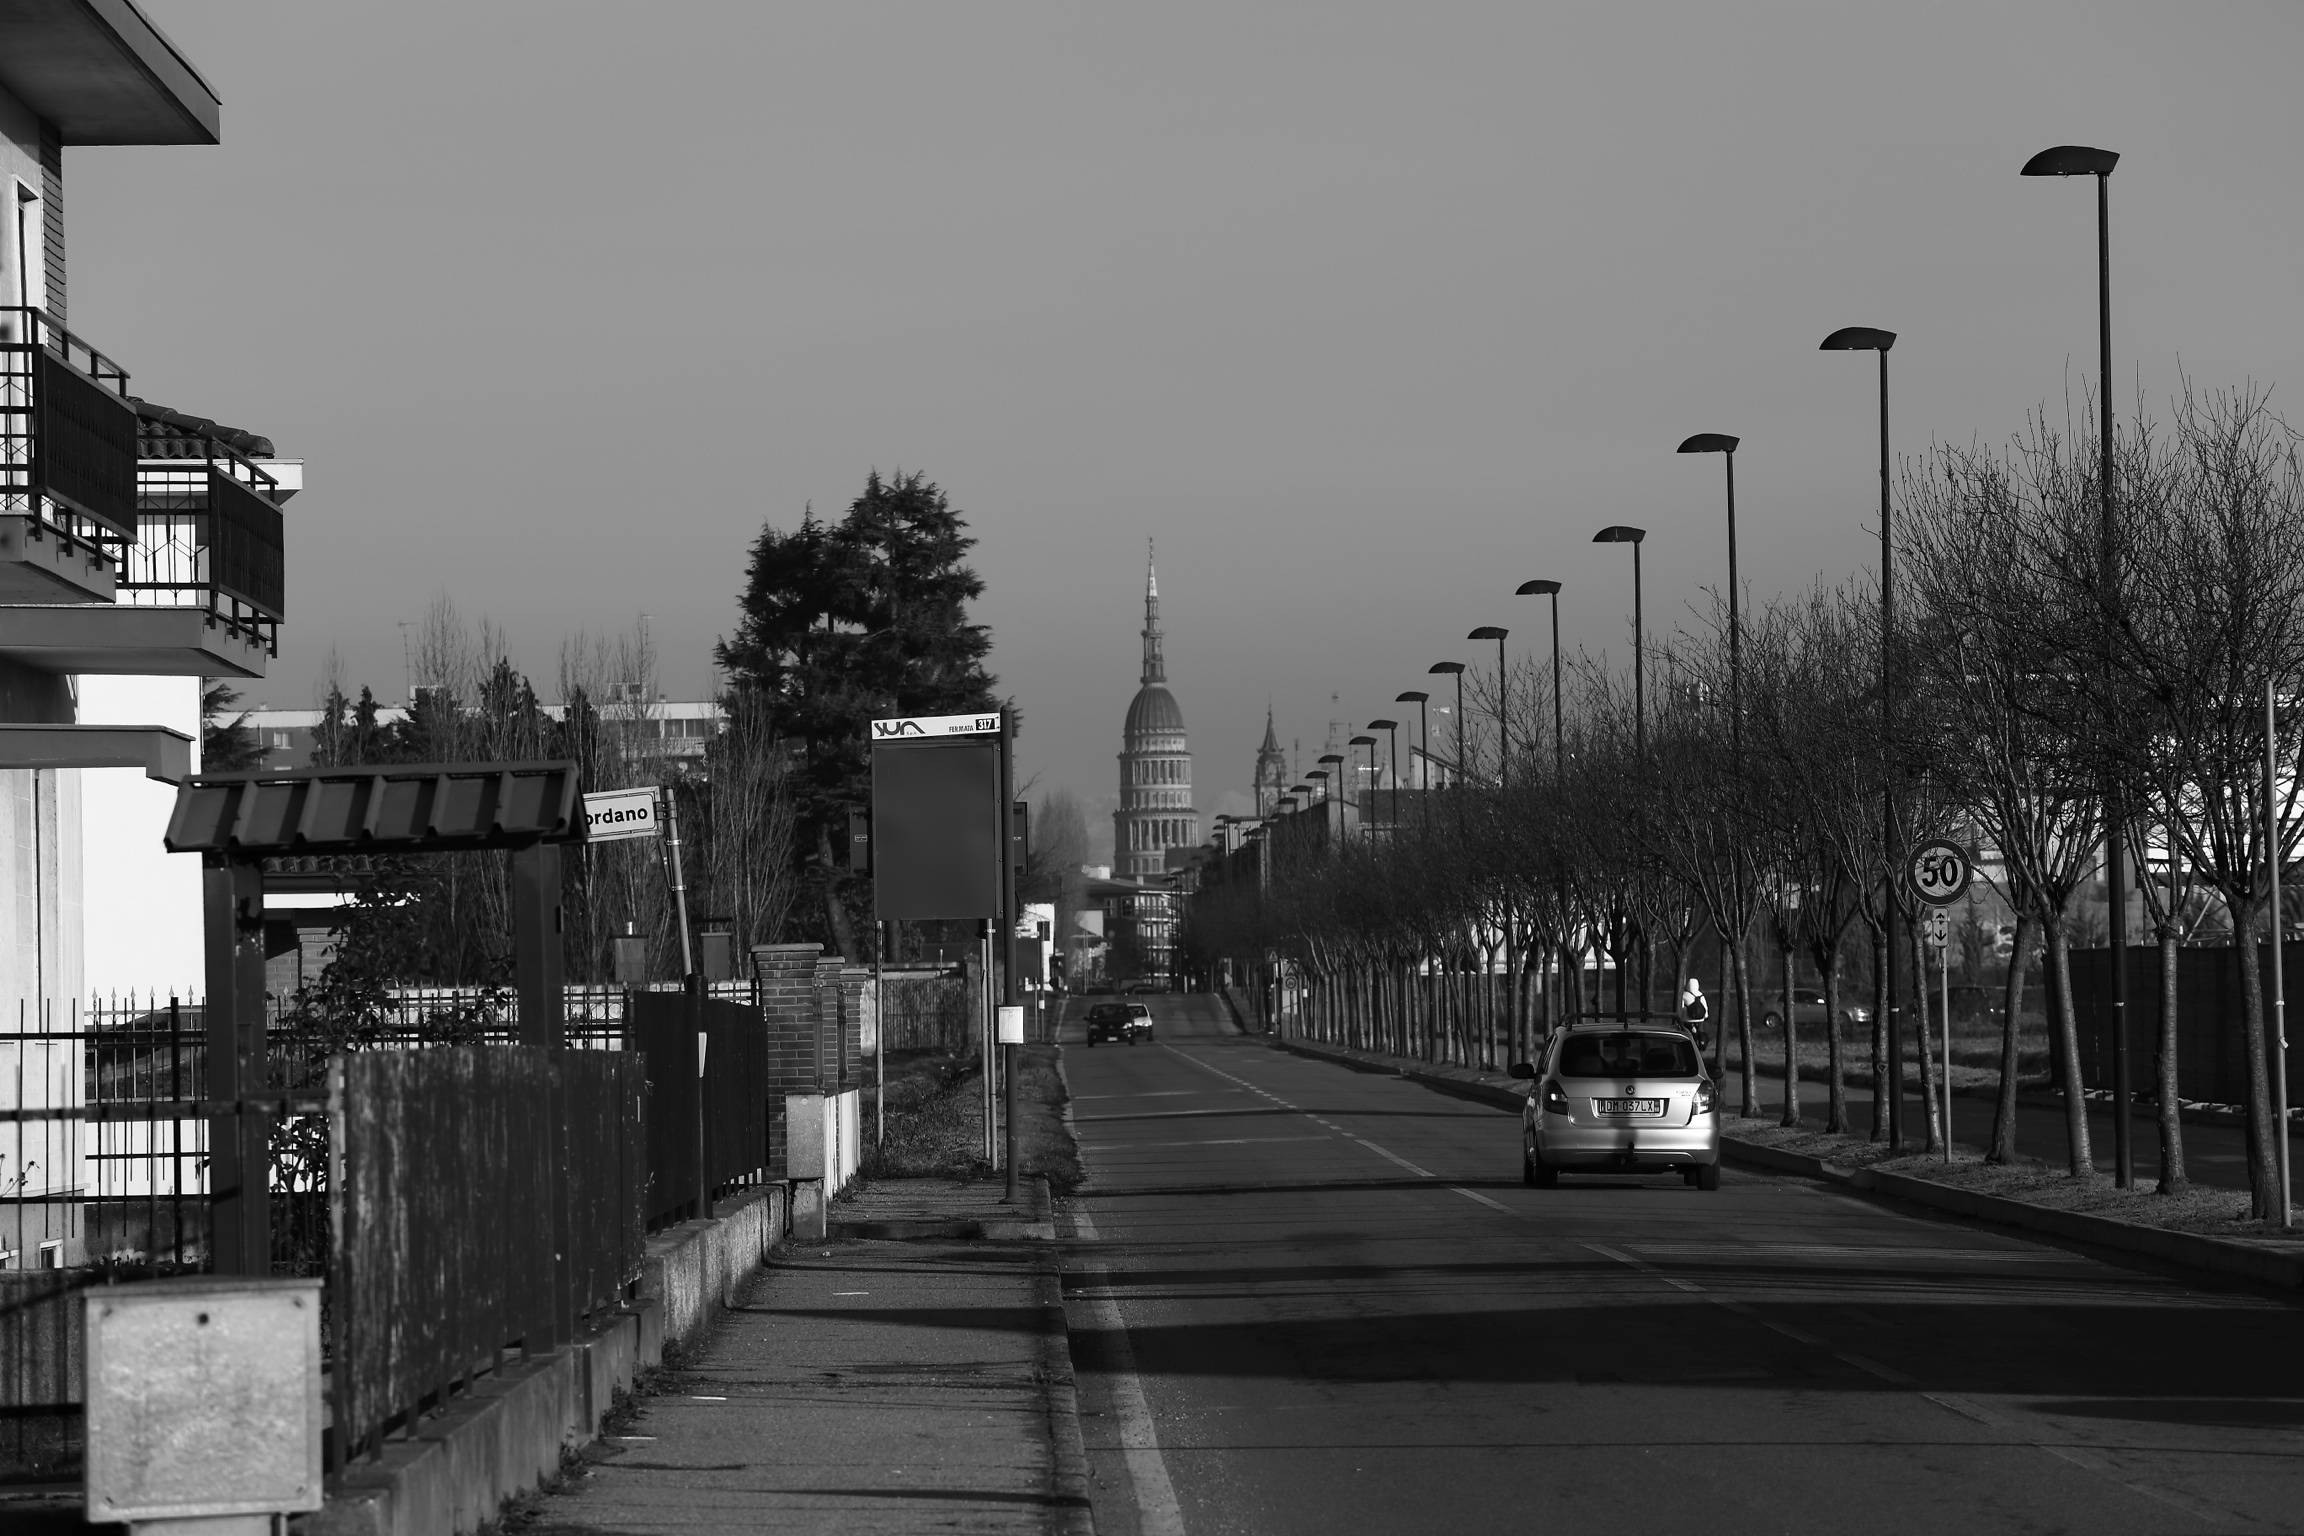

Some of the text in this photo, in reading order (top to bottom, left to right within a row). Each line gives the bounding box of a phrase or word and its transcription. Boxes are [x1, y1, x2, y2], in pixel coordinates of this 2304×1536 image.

[948, 719, 992, 733] FERMATA 317
[1922, 856, 1958, 887] 50
[1606, 1101, 1619, 1112] DM
